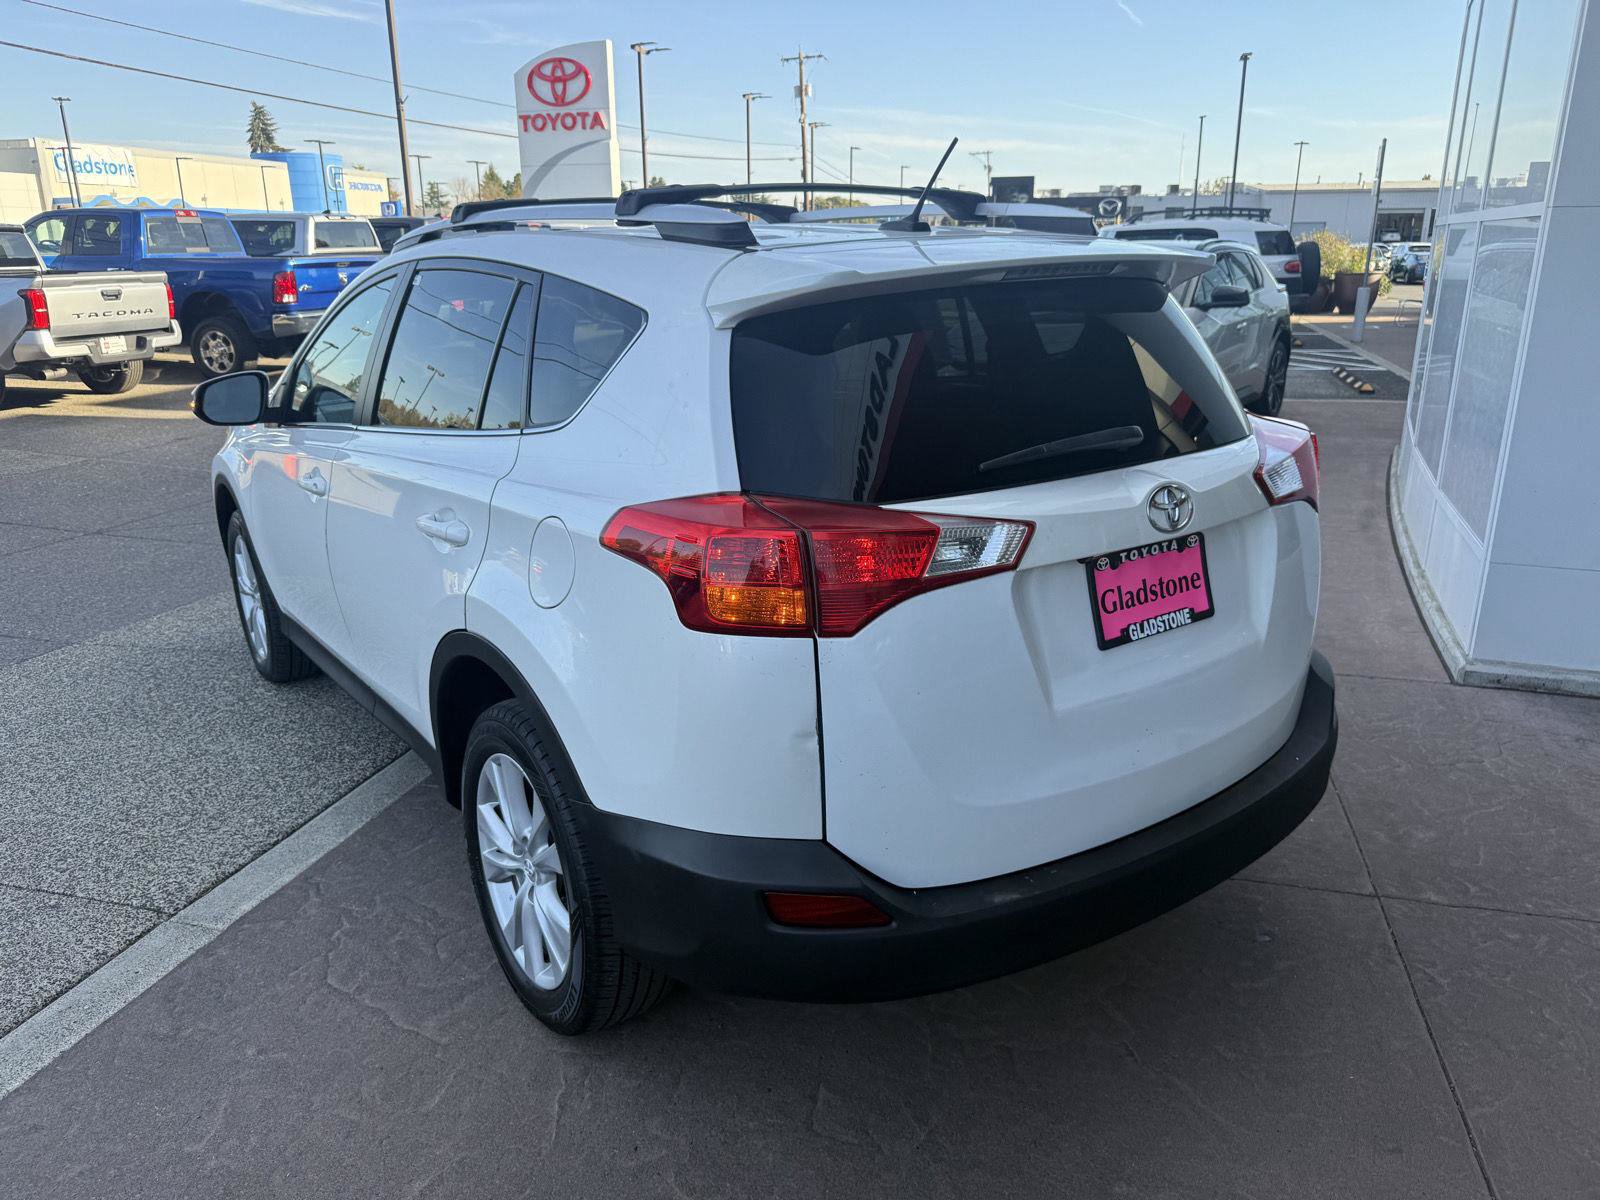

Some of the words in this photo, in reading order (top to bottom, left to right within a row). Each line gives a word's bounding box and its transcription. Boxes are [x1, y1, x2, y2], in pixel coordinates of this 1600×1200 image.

[519, 112, 607, 132] TOYOTA
[349, 181, 383, 192] HONDA
[72, 308, 154, 319] TACOMA
[1120, 539, 1178, 563] TOYOTA
[1101, 571, 1202, 615] Gladstone
[1129, 608, 1192, 641] GLADSTONE
